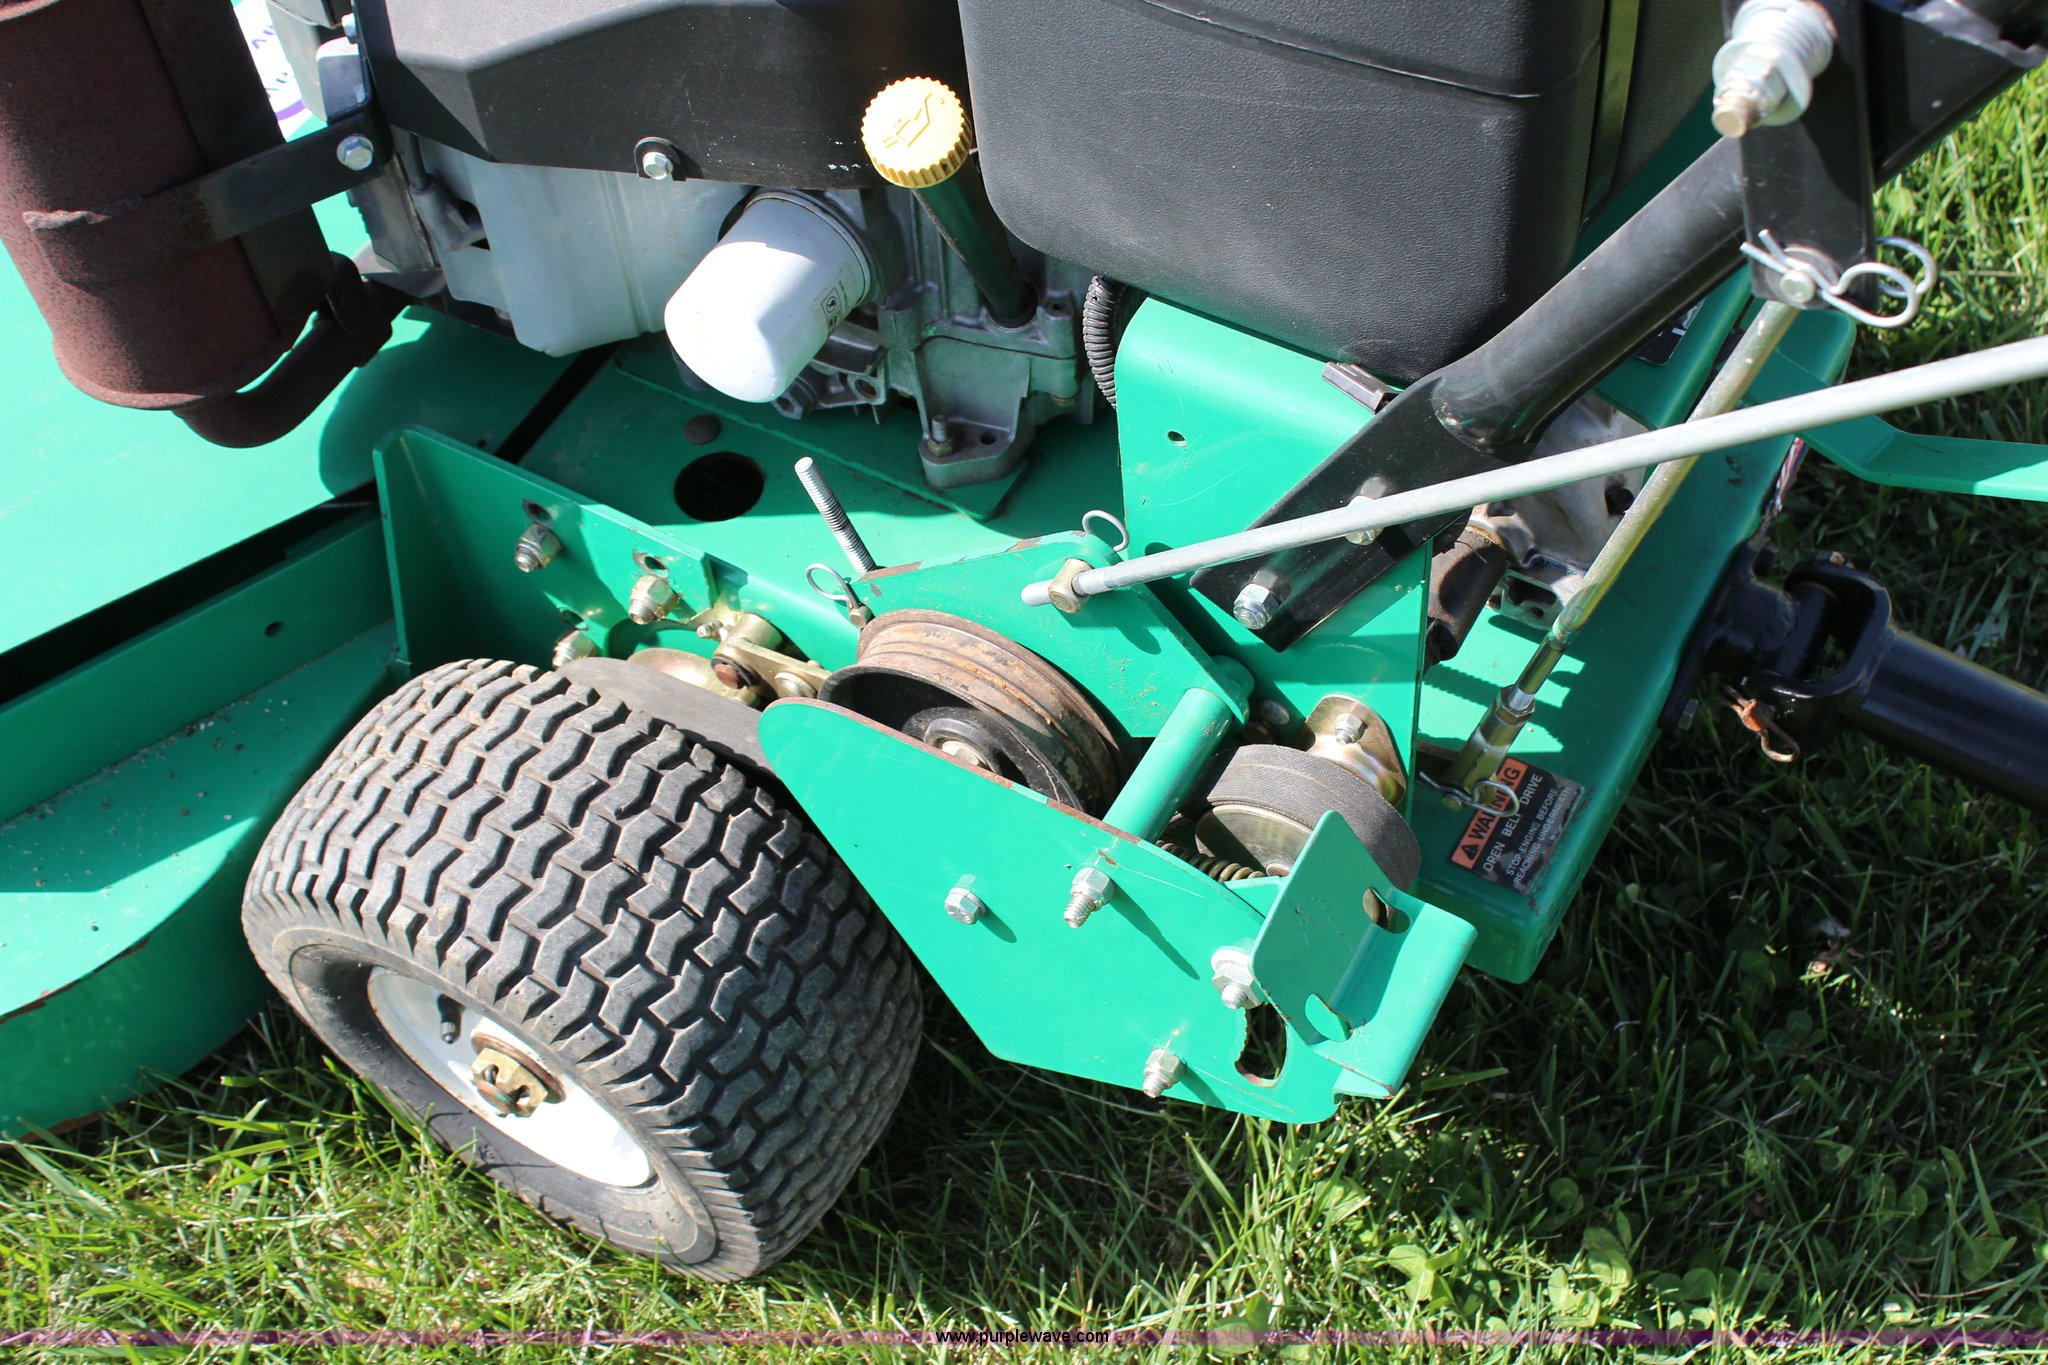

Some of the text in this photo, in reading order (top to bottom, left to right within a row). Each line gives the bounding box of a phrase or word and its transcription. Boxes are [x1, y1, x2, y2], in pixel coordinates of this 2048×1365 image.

[1483, 842, 1506, 873] OPEN
[1520, 773, 1543, 805] DRIVE
[1506, 787, 1559, 875] STOP ENGINE BEFORE
[1513, 786, 1572, 885] REACHING UNDERNEATH
